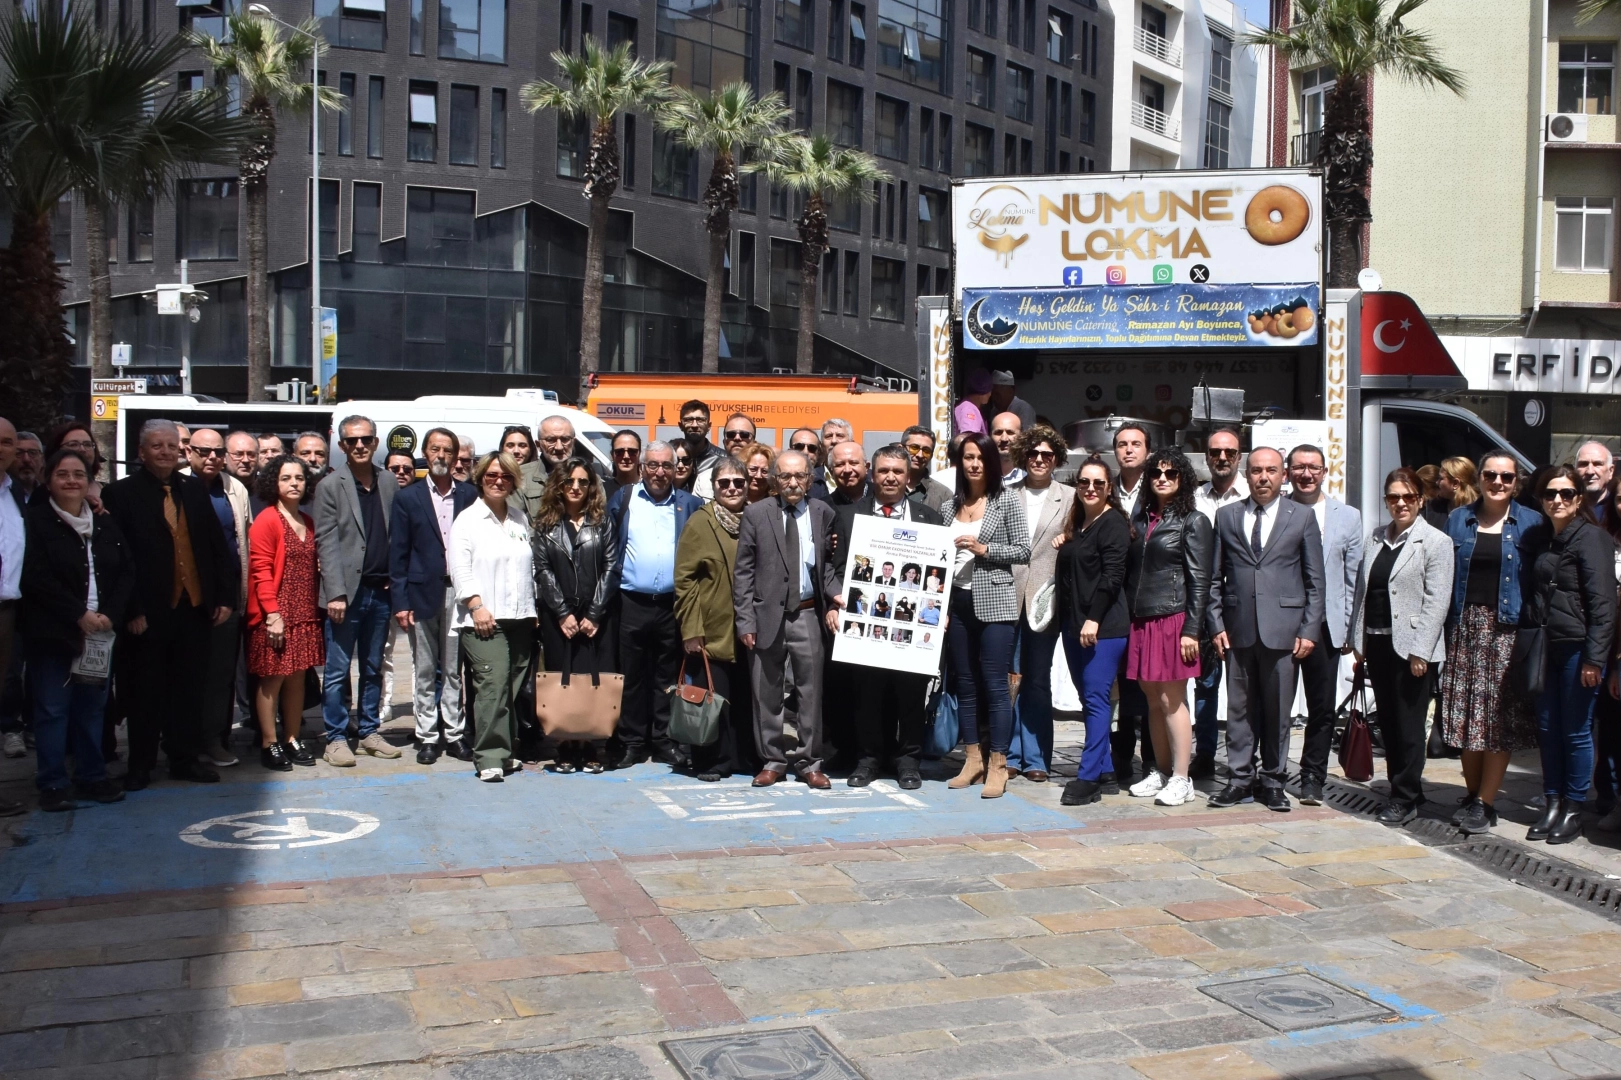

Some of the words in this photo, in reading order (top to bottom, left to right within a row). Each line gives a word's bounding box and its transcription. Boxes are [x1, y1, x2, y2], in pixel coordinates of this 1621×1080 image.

[1039, 188, 1234, 226] NUMUNE
[967, 203, 1025, 235] Lokma
[1061, 227, 1212, 261] LOKMA
[1018, 296, 1045, 316] Hoş
[1050, 296, 1095, 319] Geldin
[1099, 294, 1119, 317] Ya
[1177, 294, 1245, 317] Ramazan
[1020, 320, 1073, 331] NUMUNE
[1075, 319, 1118, 332] Catering
[1128, 320, 1176, 330] Ramazan
[1178, 320, 1194, 331] Ayı
[1196, 320, 1244, 331] Boyunca,
[1105, 333, 1127, 343] Toplu
[1201, 332, 1248, 343] Etmekteyiz.
[933, 322, 949, 423] NUMUNE
[1049, 360, 1078, 375] 243
[1168, 360, 1188, 374] 48
[1193, 360, 1224, 374] 446
[1327, 317, 1345, 420] NUMUNE
[93, 382, 135, 392] Kültürpark
[606, 406, 635, 415] OKUR
[1327, 426, 1345, 501] LOKM
